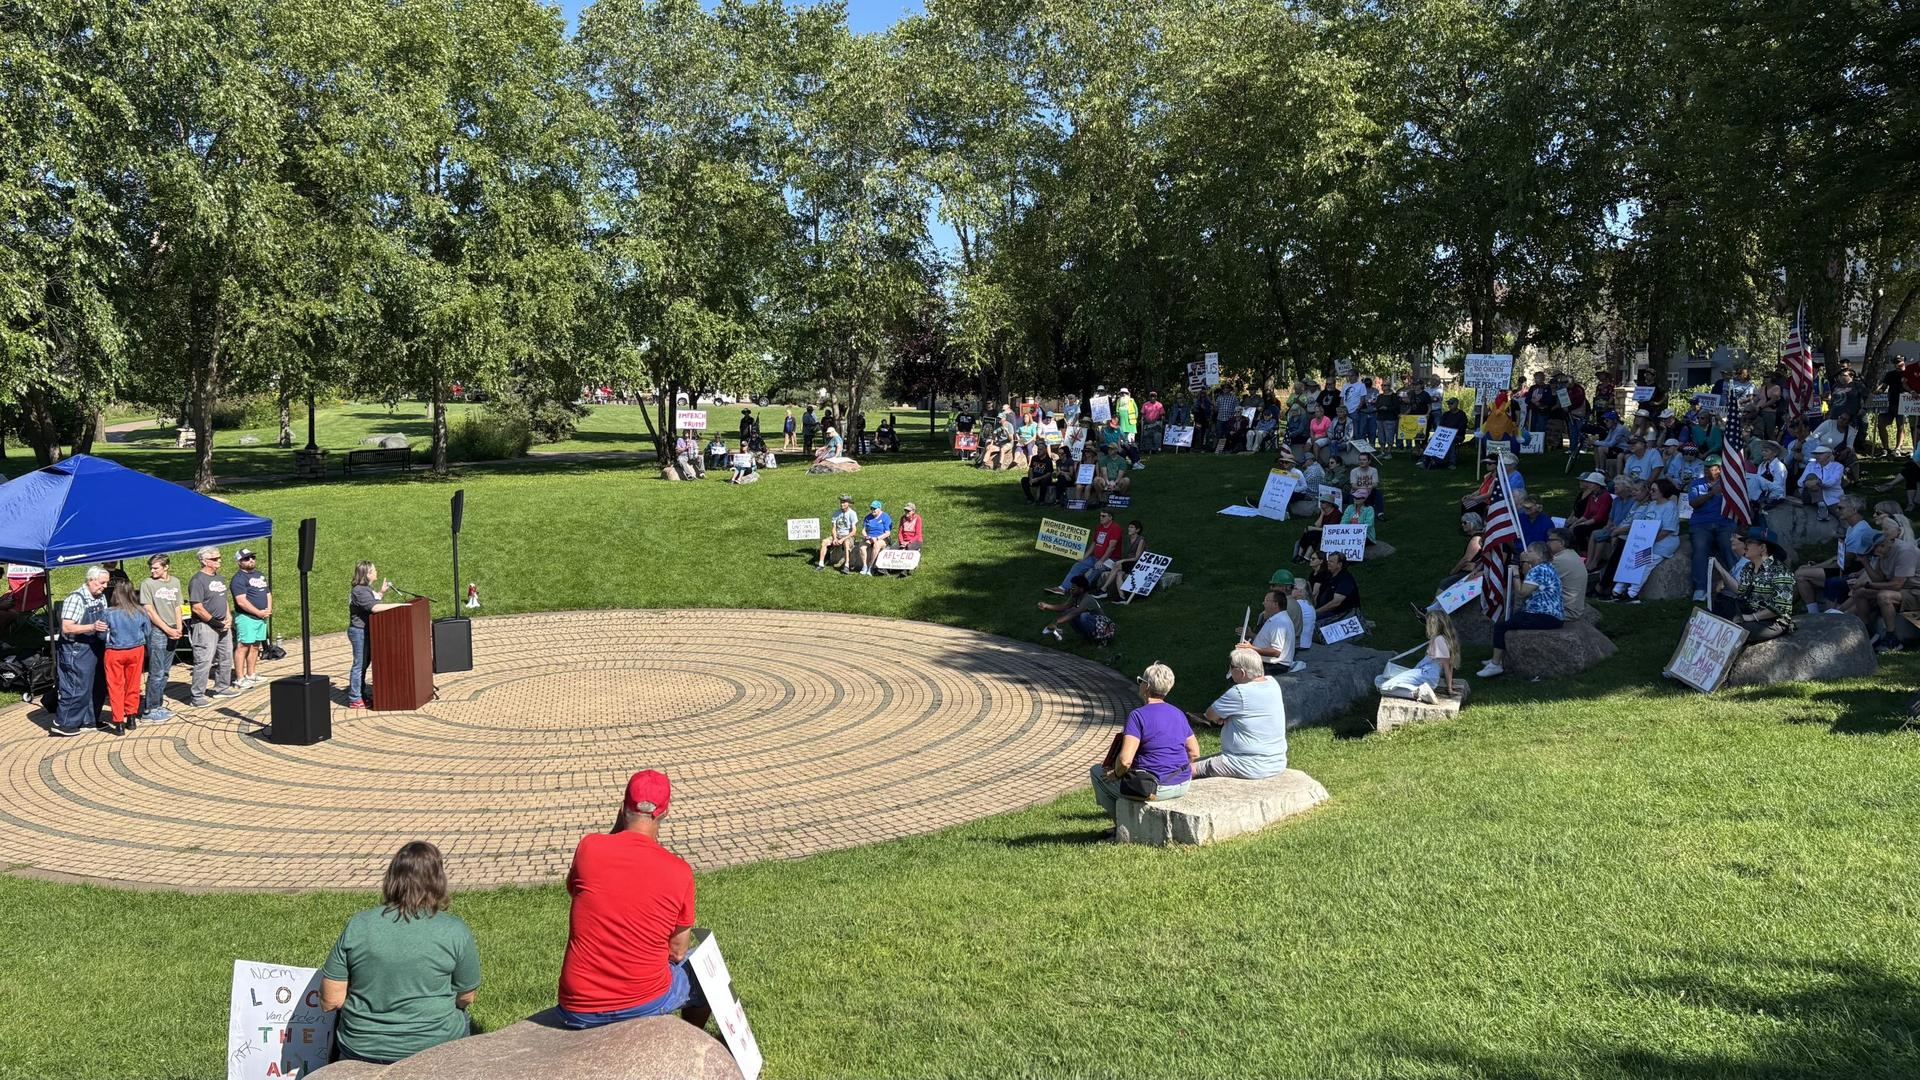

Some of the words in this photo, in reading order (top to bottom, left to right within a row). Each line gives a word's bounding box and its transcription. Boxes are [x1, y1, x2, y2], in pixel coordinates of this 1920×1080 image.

[1482, 381, 1502, 389] PEOPLE
[1044, 519, 1066, 531] HIGHER
[1066, 525, 1088, 537] PRICES
[1046, 528, 1059, 536] ARE
[1060, 531, 1073, 539] DUE
[1041, 533, 1053, 543] HIS
[1053, 538, 1083, 551] ACTIONS
[1348, 538, 1362, 546] IT'S
[1052, 544, 1069, 554] Trump
[882, 551, 914, 560] AFL-CIO
[1139, 552, 1170, 567] SEND
[1134, 563, 1151, 572] OUT
[1153, 566, 1165, 575] THE
[1713, 623, 1734, 648] NO
